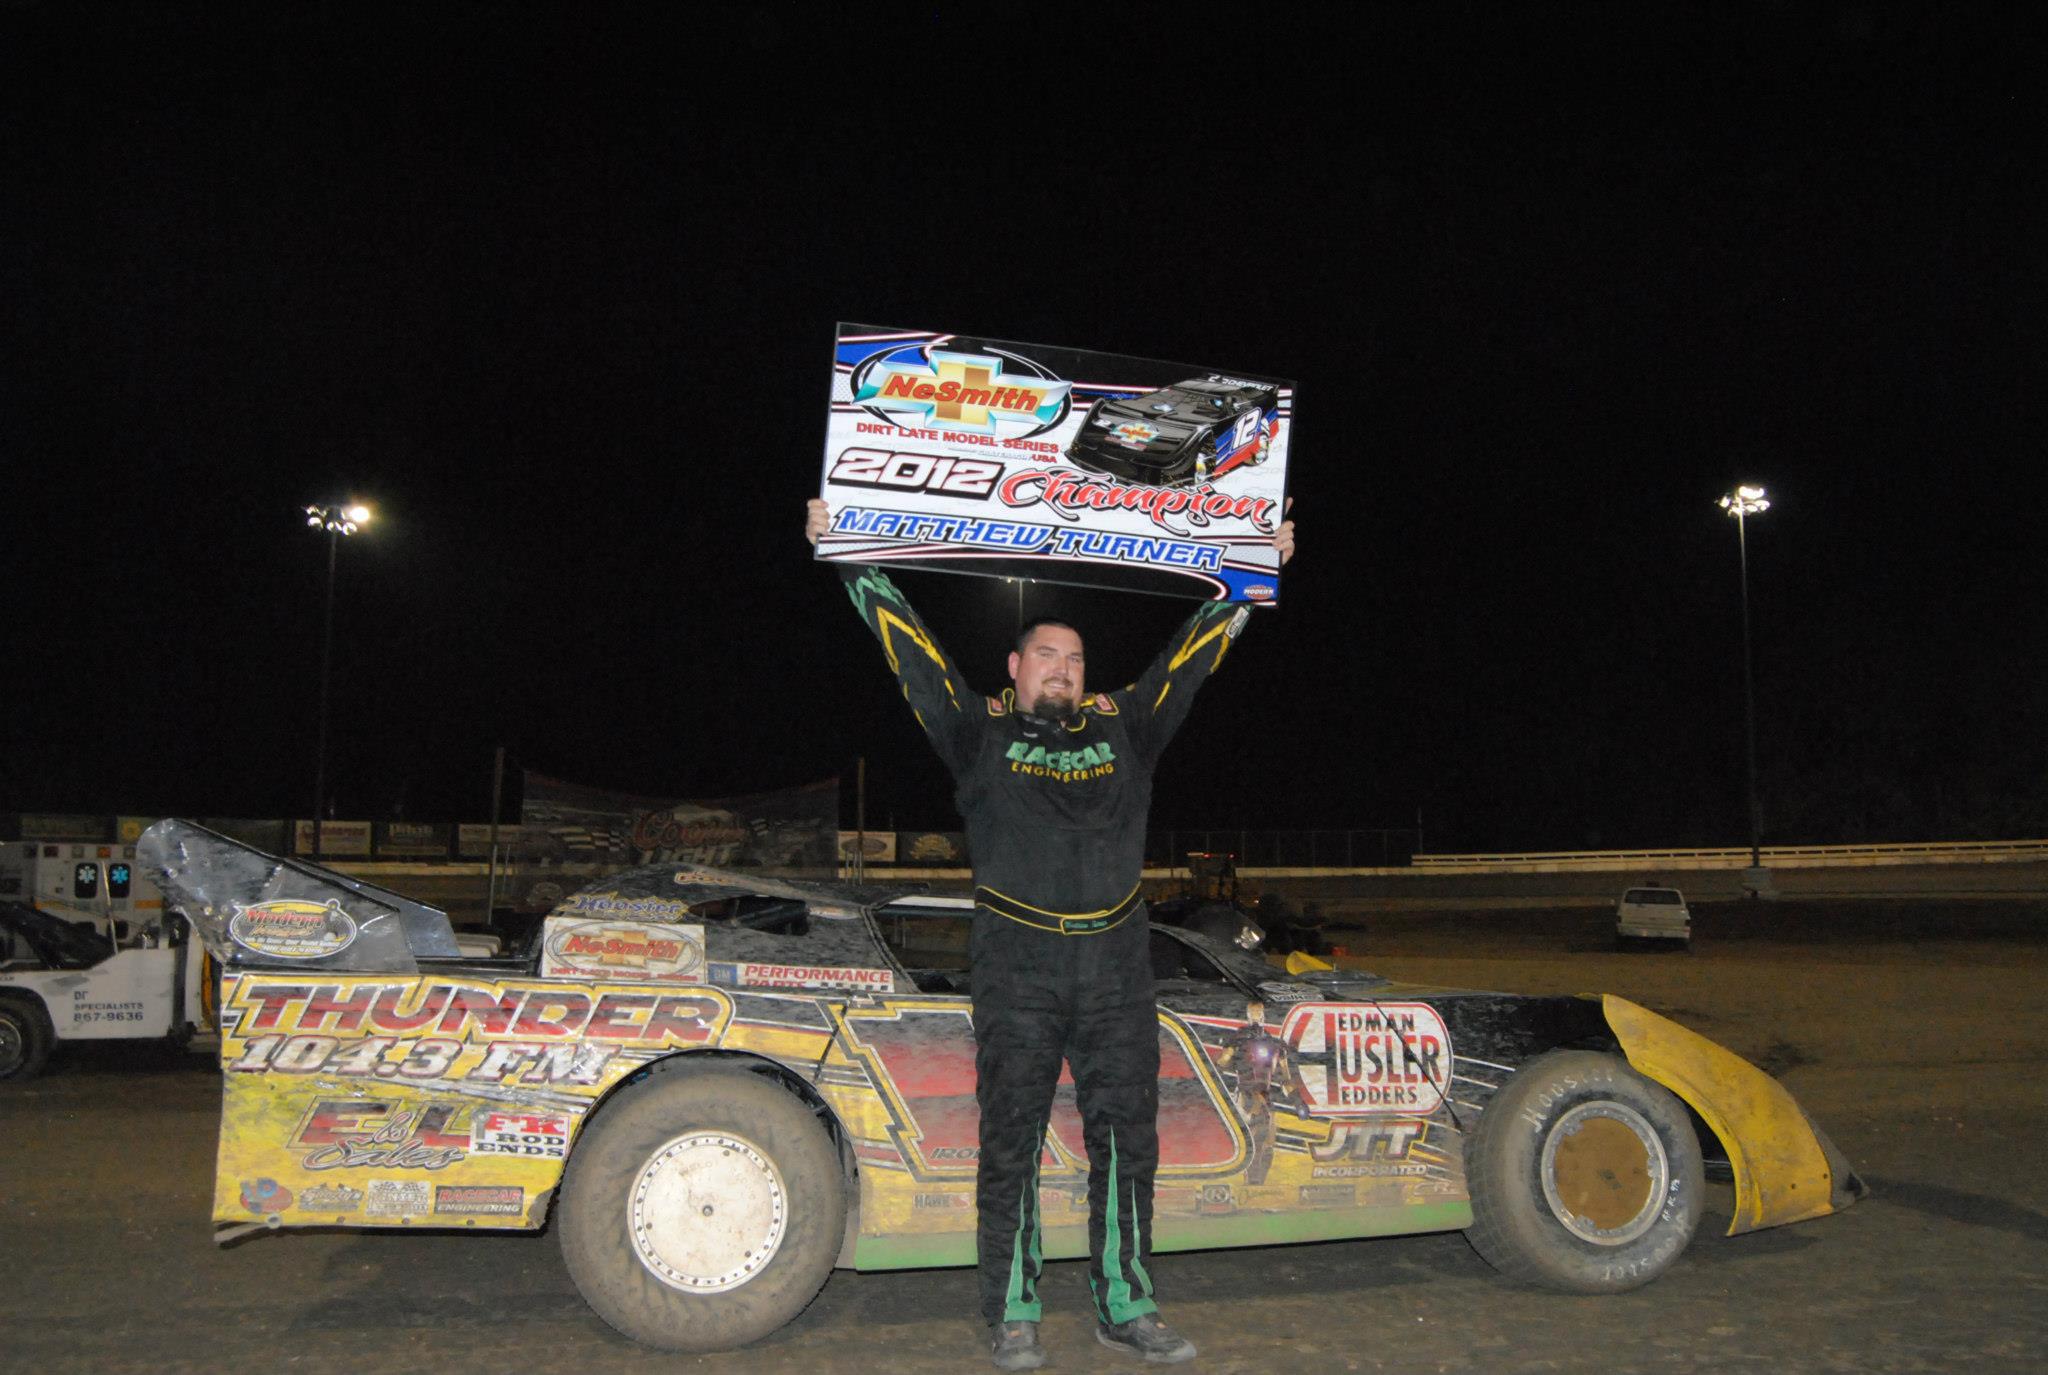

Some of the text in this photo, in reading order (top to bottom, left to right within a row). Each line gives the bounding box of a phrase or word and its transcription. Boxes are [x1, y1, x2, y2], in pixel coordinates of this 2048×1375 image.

[884, 376, 1038, 412] NeSmith
[856, 421, 1060, 454] DIRT LATE MODEL SERIES
[1032, 453, 1058, 464] USA
[829, 447, 1277, 539] 2012 Champion
[835, 508, 1225, 570] MATTHEW TURNER
[1005, 741, 1116, 772] RACECAR
[1011, 762, 1115, 783] ENGINEERING
[564, 934, 681, 960] NeSmith
[744, 965, 891, 984] PERFORMANCE
[74, 1002, 144, 1010] SPECIALISTS
[247, 983, 724, 1042] THUNDER
[73, 1012, 144, 1022] 867-9636
[231, 1034, 627, 1086] 104.3 FM
[484, 1113, 566, 1136] FK
[495, 1132, 567, 1147] ROD
[474, 1142, 567, 1158] ENDS
[930, 1147, 982, 1160] IRO
[1312, 1165, 1427, 1178] INCORPORATED
[438, 1189, 522, 1204] RACECAR
[436, 1203, 521, 1214] ENGINEERING
